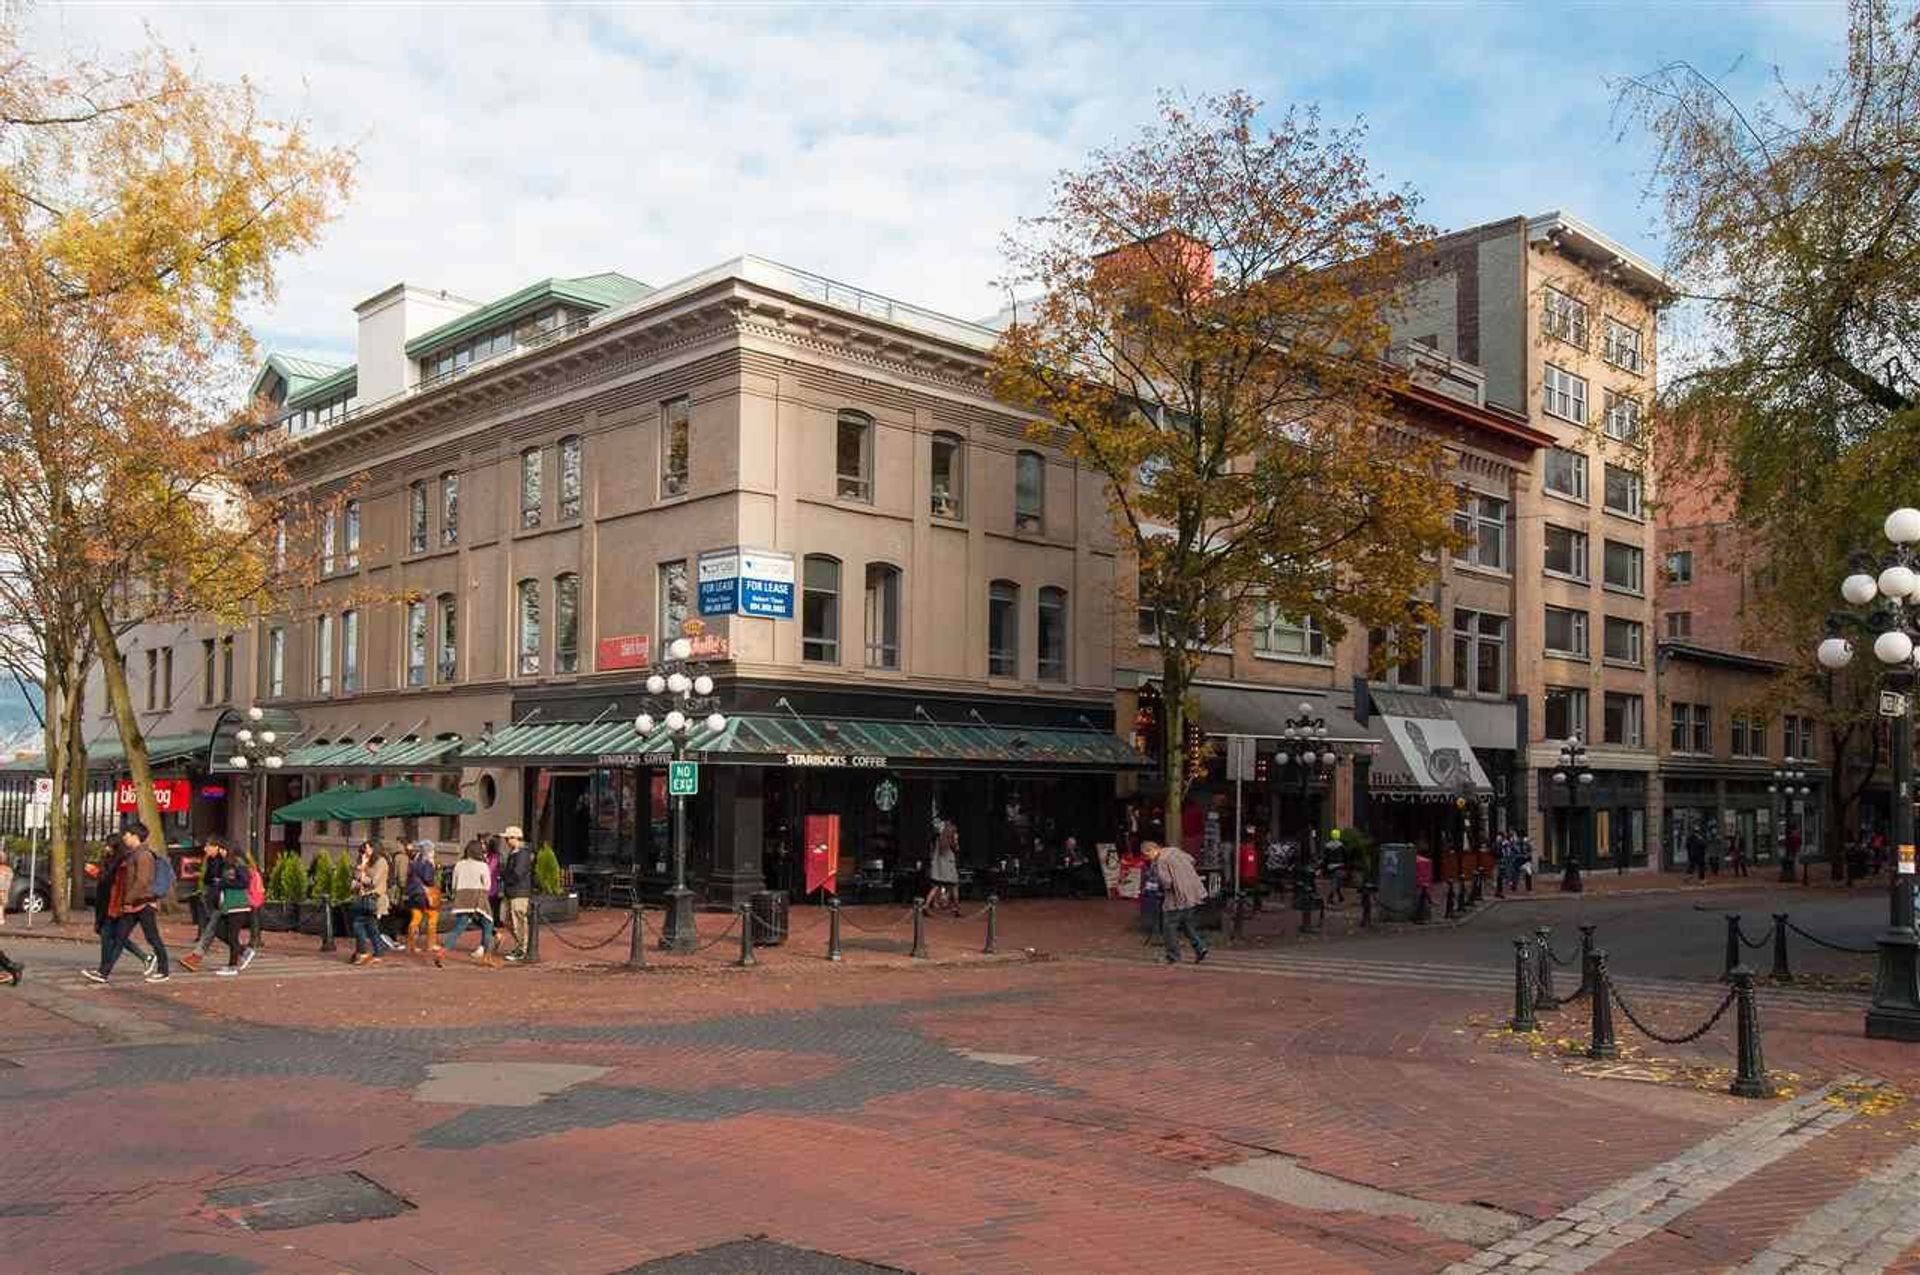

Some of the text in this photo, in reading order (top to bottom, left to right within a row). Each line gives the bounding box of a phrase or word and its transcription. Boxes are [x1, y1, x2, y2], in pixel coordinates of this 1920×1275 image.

[746, 580, 789, 594] FOR LEASE
[786, 754, 887, 767] STARBUCKS COFFEE
[676, 766, 691, 778] NO
[673, 778, 693, 791] EXIT
